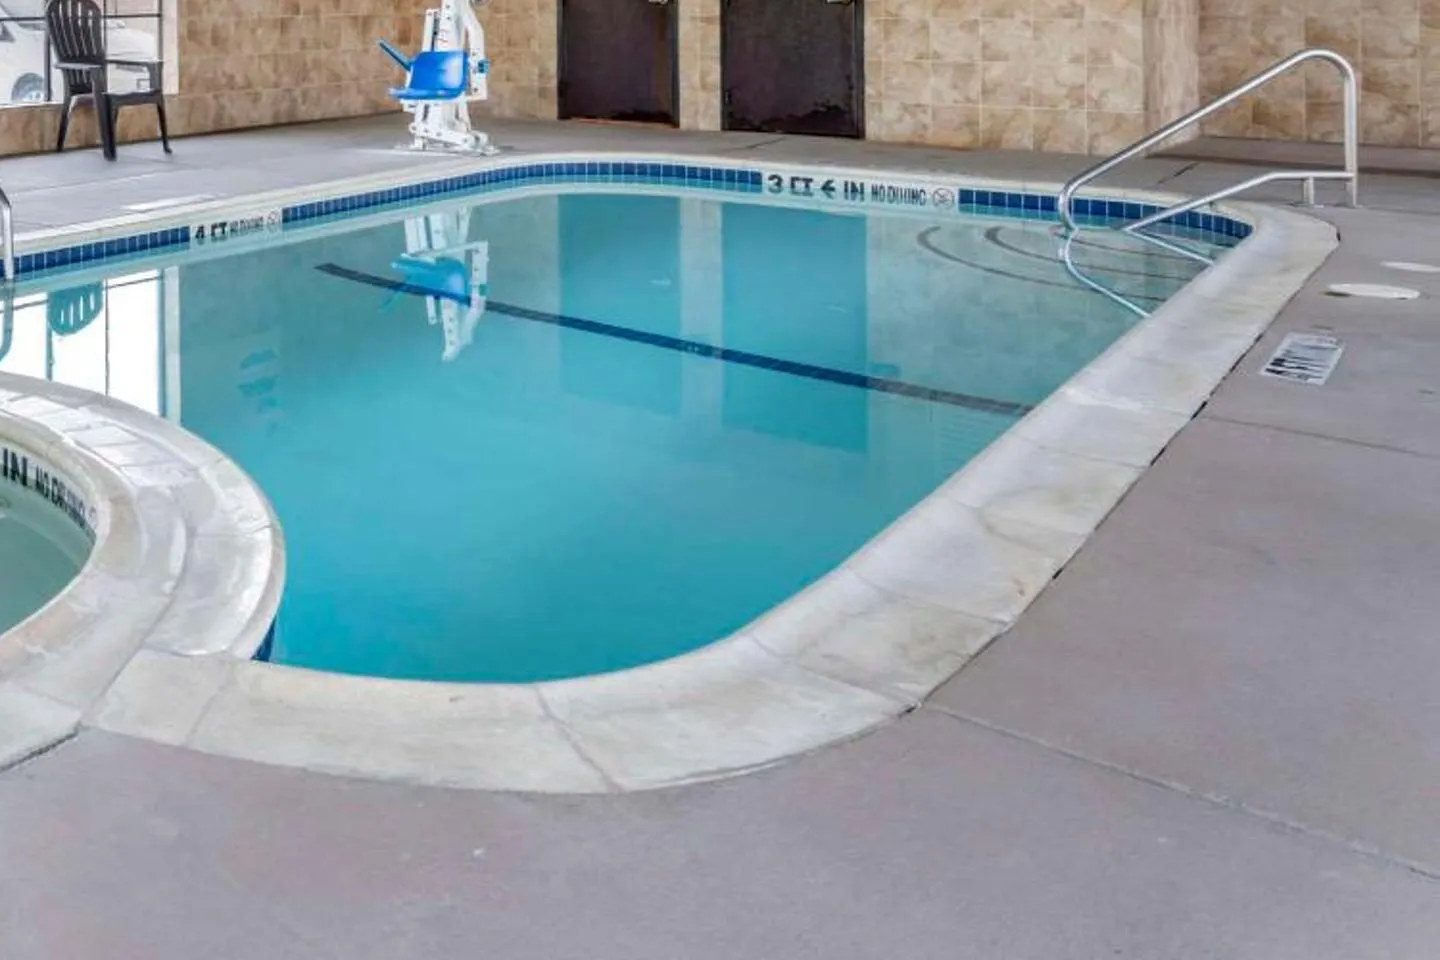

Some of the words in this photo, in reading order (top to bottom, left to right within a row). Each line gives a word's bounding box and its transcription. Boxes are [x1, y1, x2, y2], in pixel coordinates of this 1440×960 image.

[768, 174, 783, 191] 3
[195, 224, 204, 238] 4
[3, 448, 28, 486] IN
